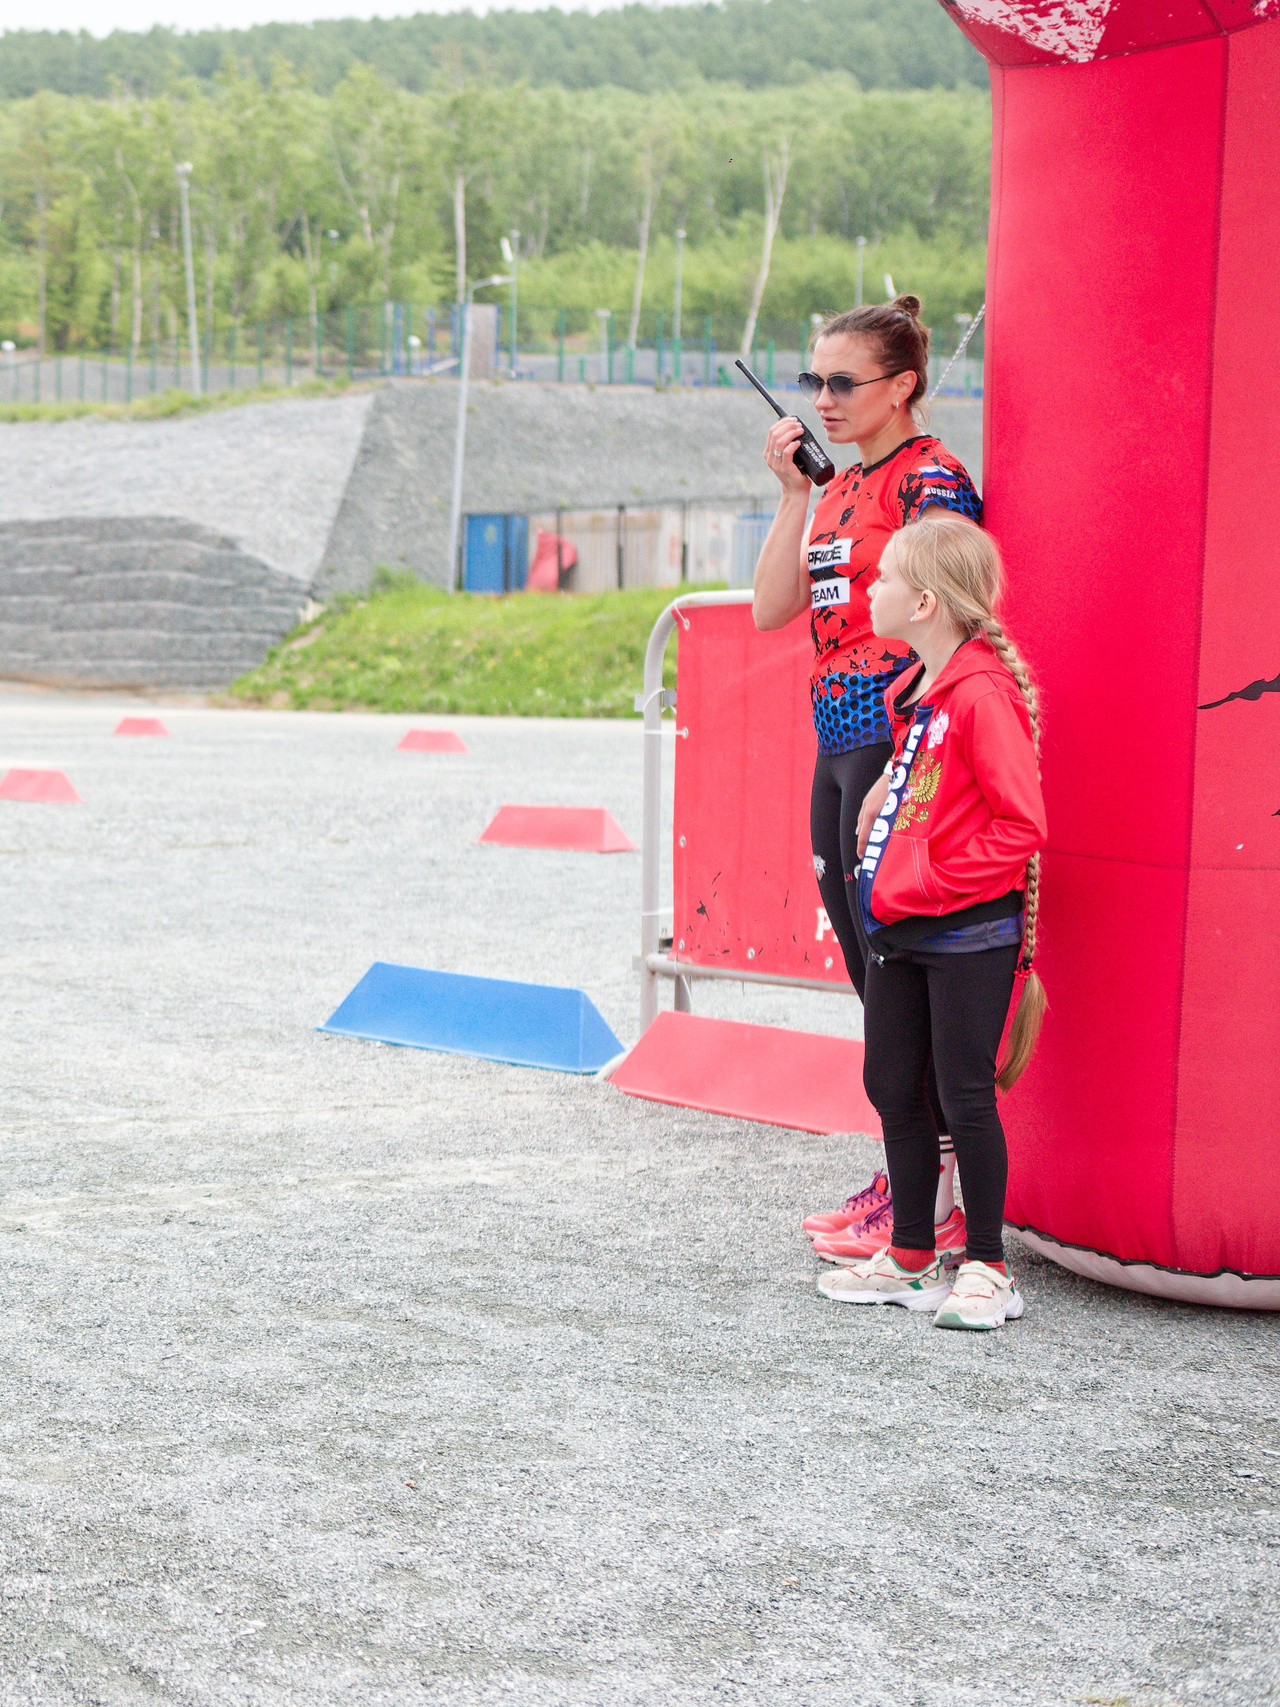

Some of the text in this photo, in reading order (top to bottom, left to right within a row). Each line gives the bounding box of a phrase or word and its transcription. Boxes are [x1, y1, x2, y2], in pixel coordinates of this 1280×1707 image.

[923, 486, 957, 500] RUSSIA
[808, 545, 842, 565] PRIDE
[811, 585, 840, 603] TEAM
